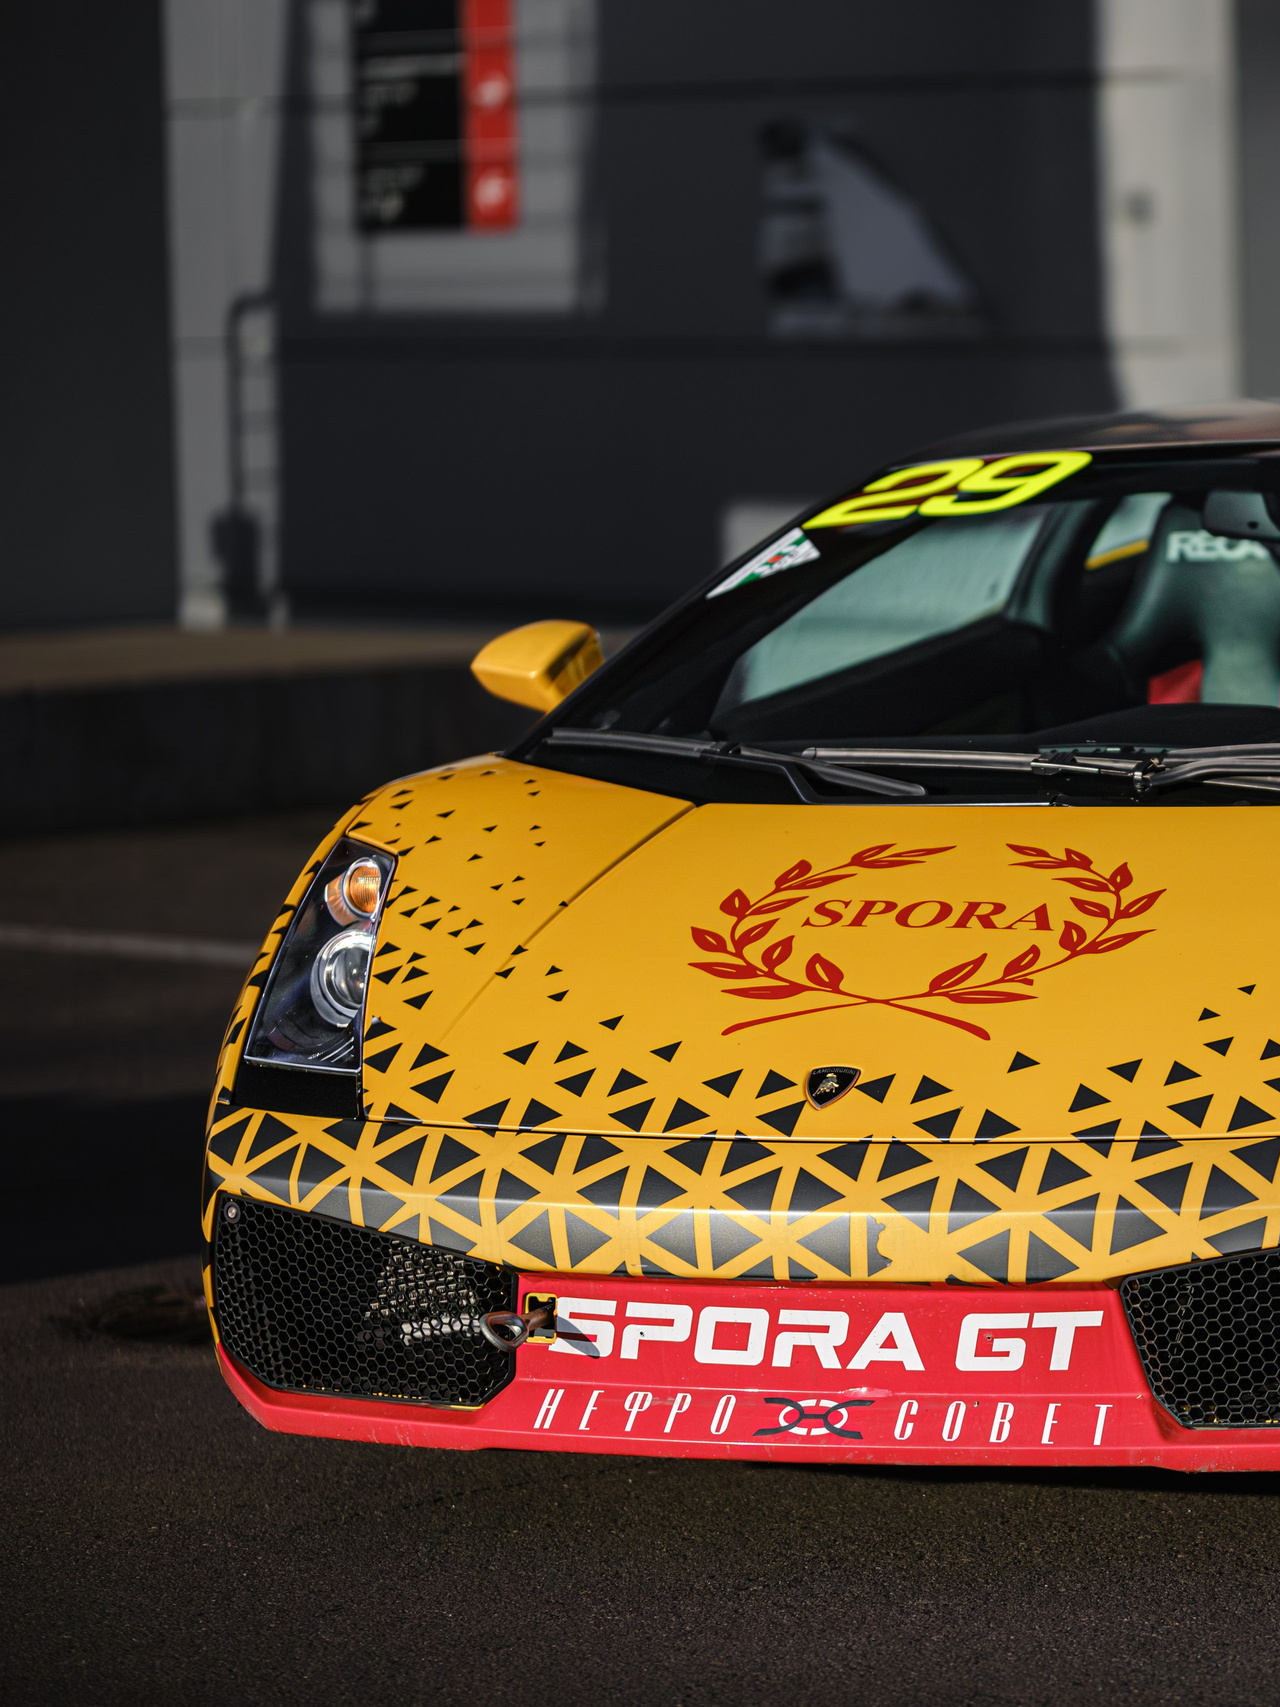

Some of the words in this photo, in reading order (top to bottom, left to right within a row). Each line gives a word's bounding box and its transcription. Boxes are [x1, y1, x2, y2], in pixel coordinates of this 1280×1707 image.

[801, 450, 1093, 530] 29
[801, 899, 1055, 931] SPORA
[549, 1296, 925, 1371] SPORA
[955, 1310, 1104, 1372] GT
[533, 1388, 738, 1436] НЕФРО
[894, 1399, 1114, 1446] СОВЕТ
